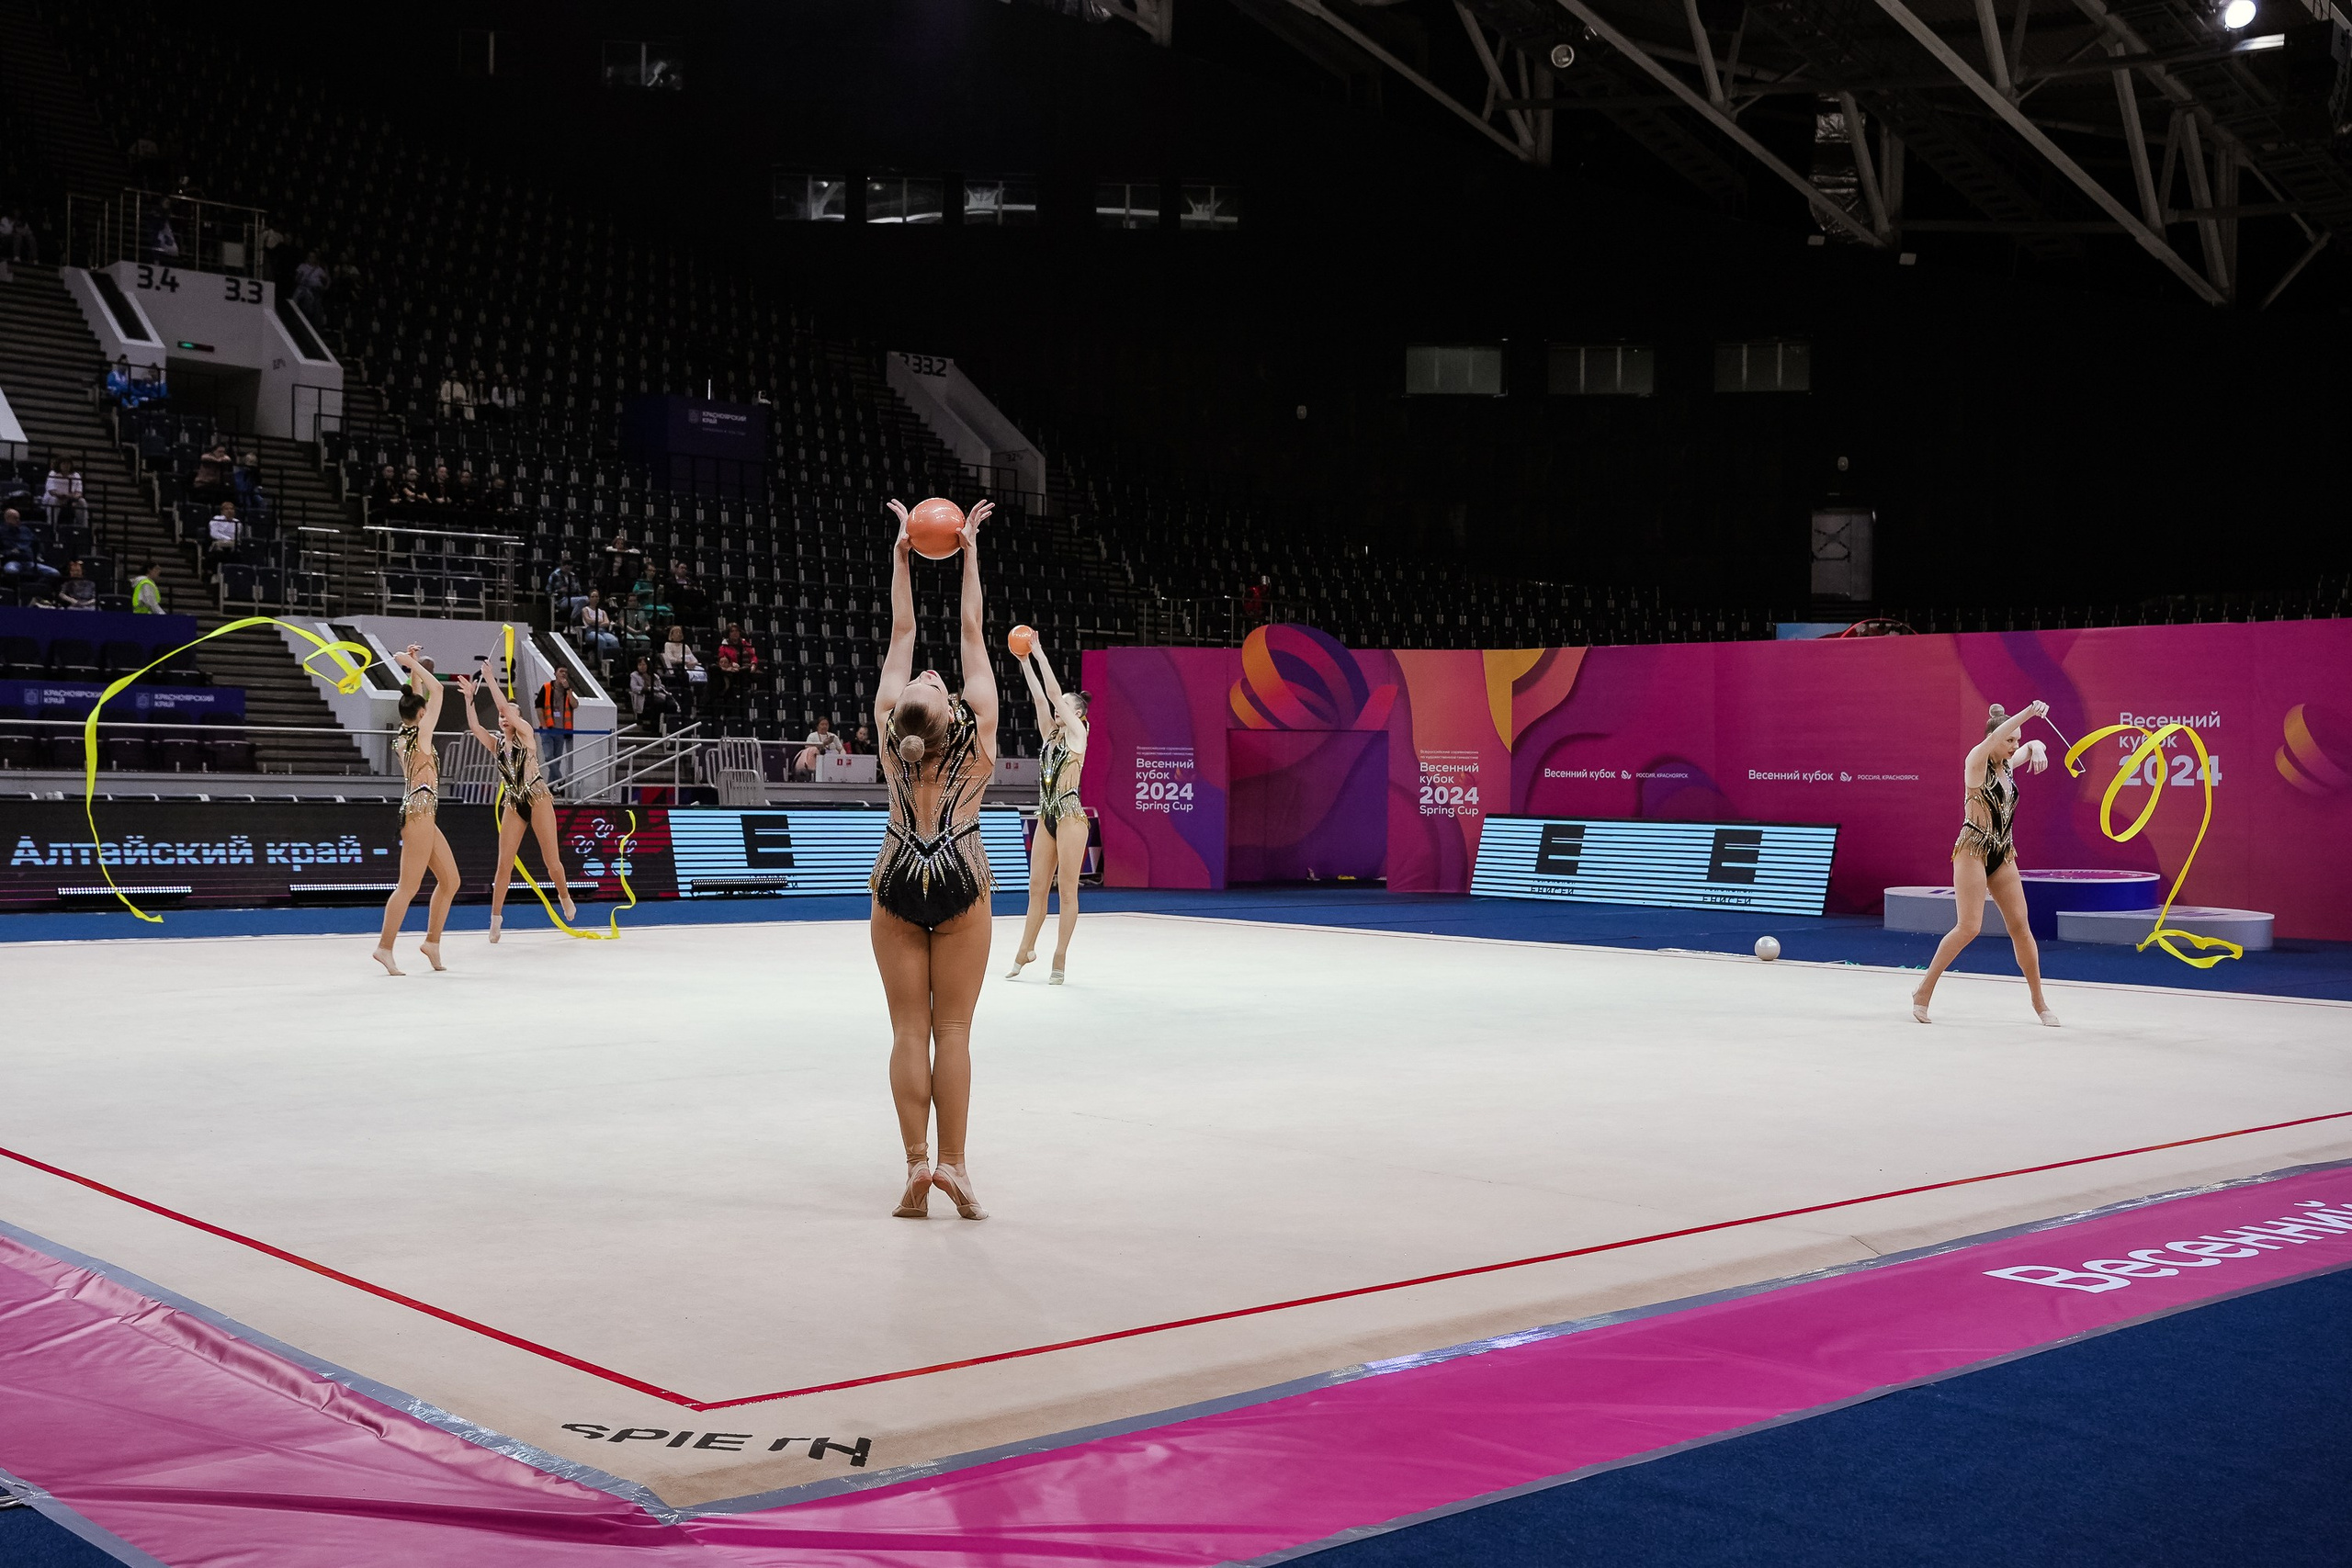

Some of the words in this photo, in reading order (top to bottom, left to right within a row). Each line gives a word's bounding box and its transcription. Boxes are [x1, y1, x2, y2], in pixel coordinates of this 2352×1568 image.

[137, 265, 179, 293] 3.4
[224, 276, 263, 304] 3.3
[43, 689, 103, 699] КРАСНОЯРСКИ
[153, 694, 215, 702] КРАСНОЯРСКИЙ
[2119, 711, 2221, 728] Весенний
[1136, 758, 1193, 769] Весенний
[1419, 761, 1479, 773] Весенний
[2119, 754, 2222, 786] 2024
[1136, 770, 1170, 782] кубок
[1419, 773, 1454, 785] кубок
[1544, 768, 1588, 778] Весенний
[1589, 769, 1616, 781] кубок
[1748, 770, 1800, 780] Весенний
[1803, 770, 1834, 783] кубок
[1136, 782, 1194, 800] 2024
[1419, 786, 1479, 805] 2024
[1136, 801, 1170, 813] Spring
[1172, 802, 1193, 813] Cup
[1419, 805, 1454, 818] Spring
[1457, 806, 1479, 818] Cup
[10, 835, 254, 866] Алтайский
[266, 835, 363, 872] край
